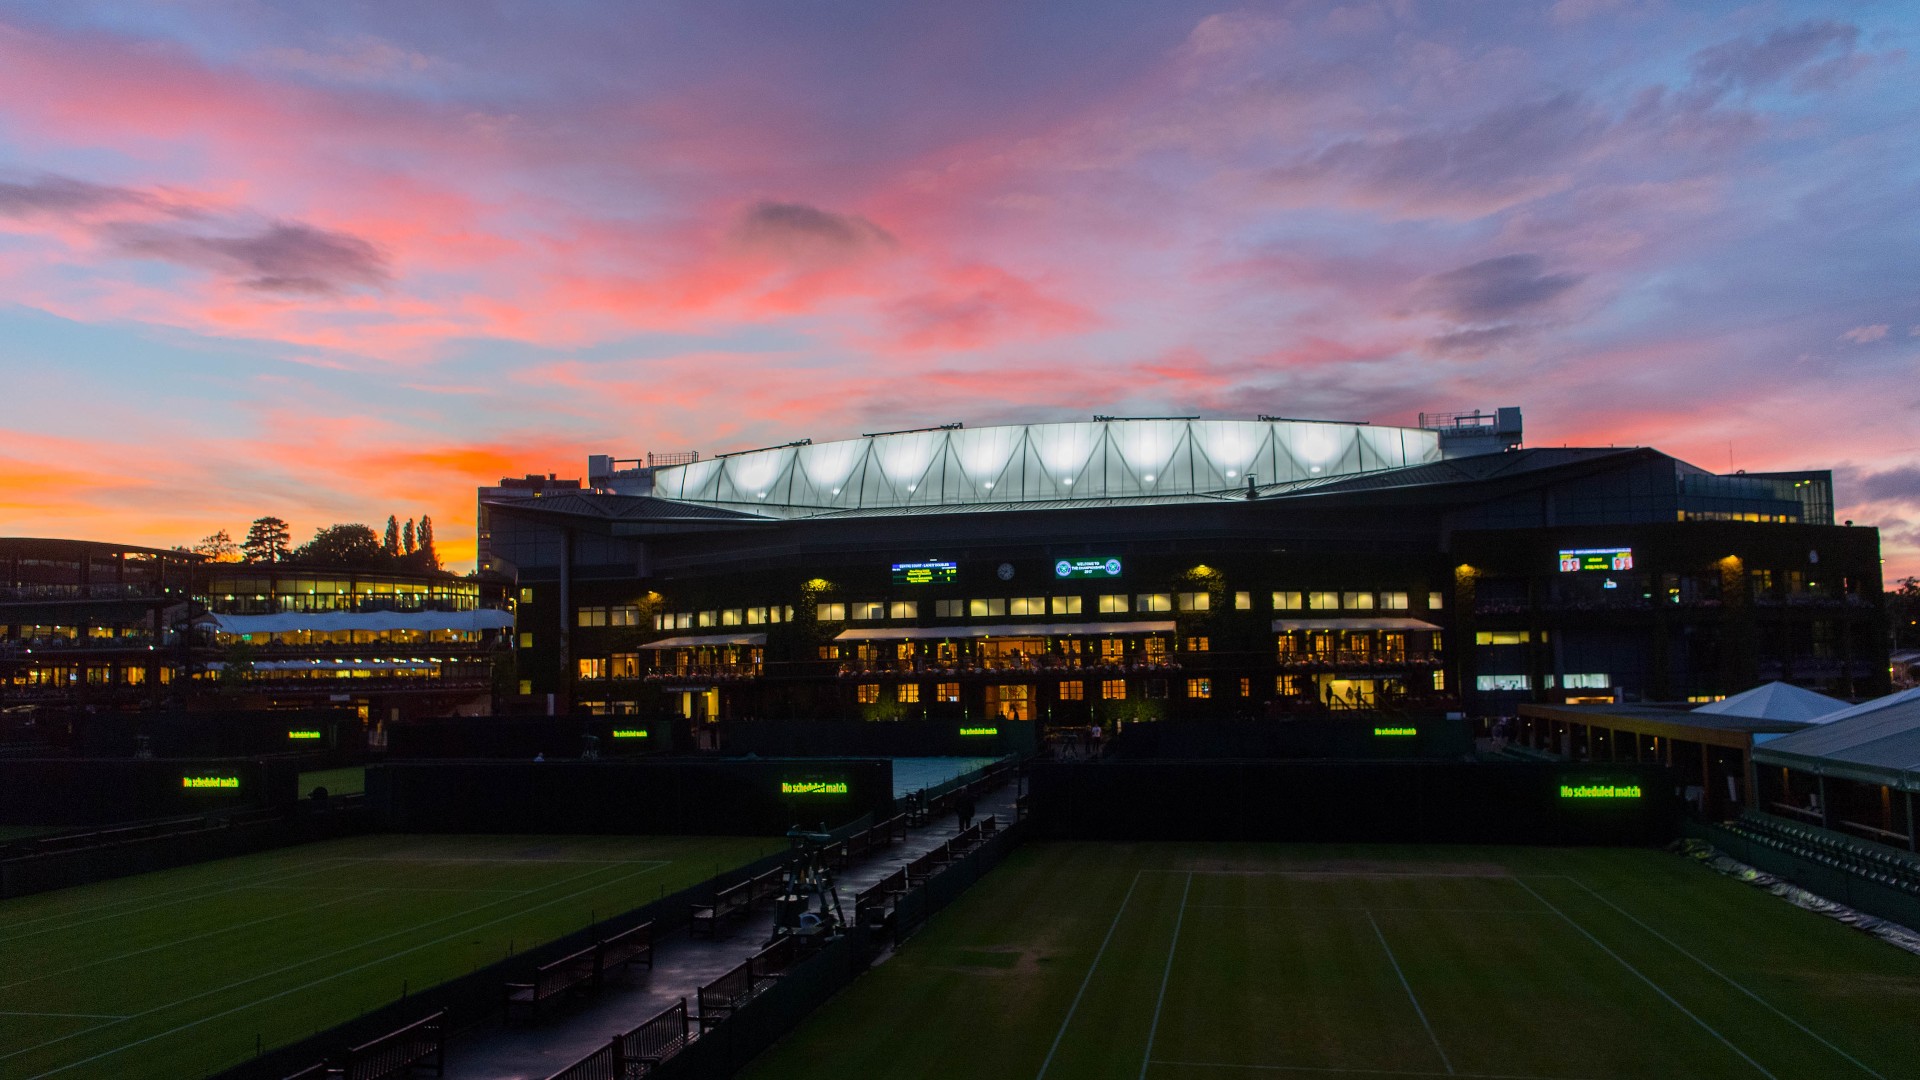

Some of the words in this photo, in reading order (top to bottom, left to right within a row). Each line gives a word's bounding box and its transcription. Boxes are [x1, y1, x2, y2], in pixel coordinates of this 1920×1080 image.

[182, 777, 192, 787] No
[192, 777, 220, 787] scheduled
[220, 777, 239, 787] match
[782, 783, 792, 793] No
[793, 783, 825, 793] scheduled
[826, 783, 847, 793] match
[1561, 786, 1573, 797] No
[1574, 786, 1614, 797] scheduled
[1615, 786, 1641, 797] match
